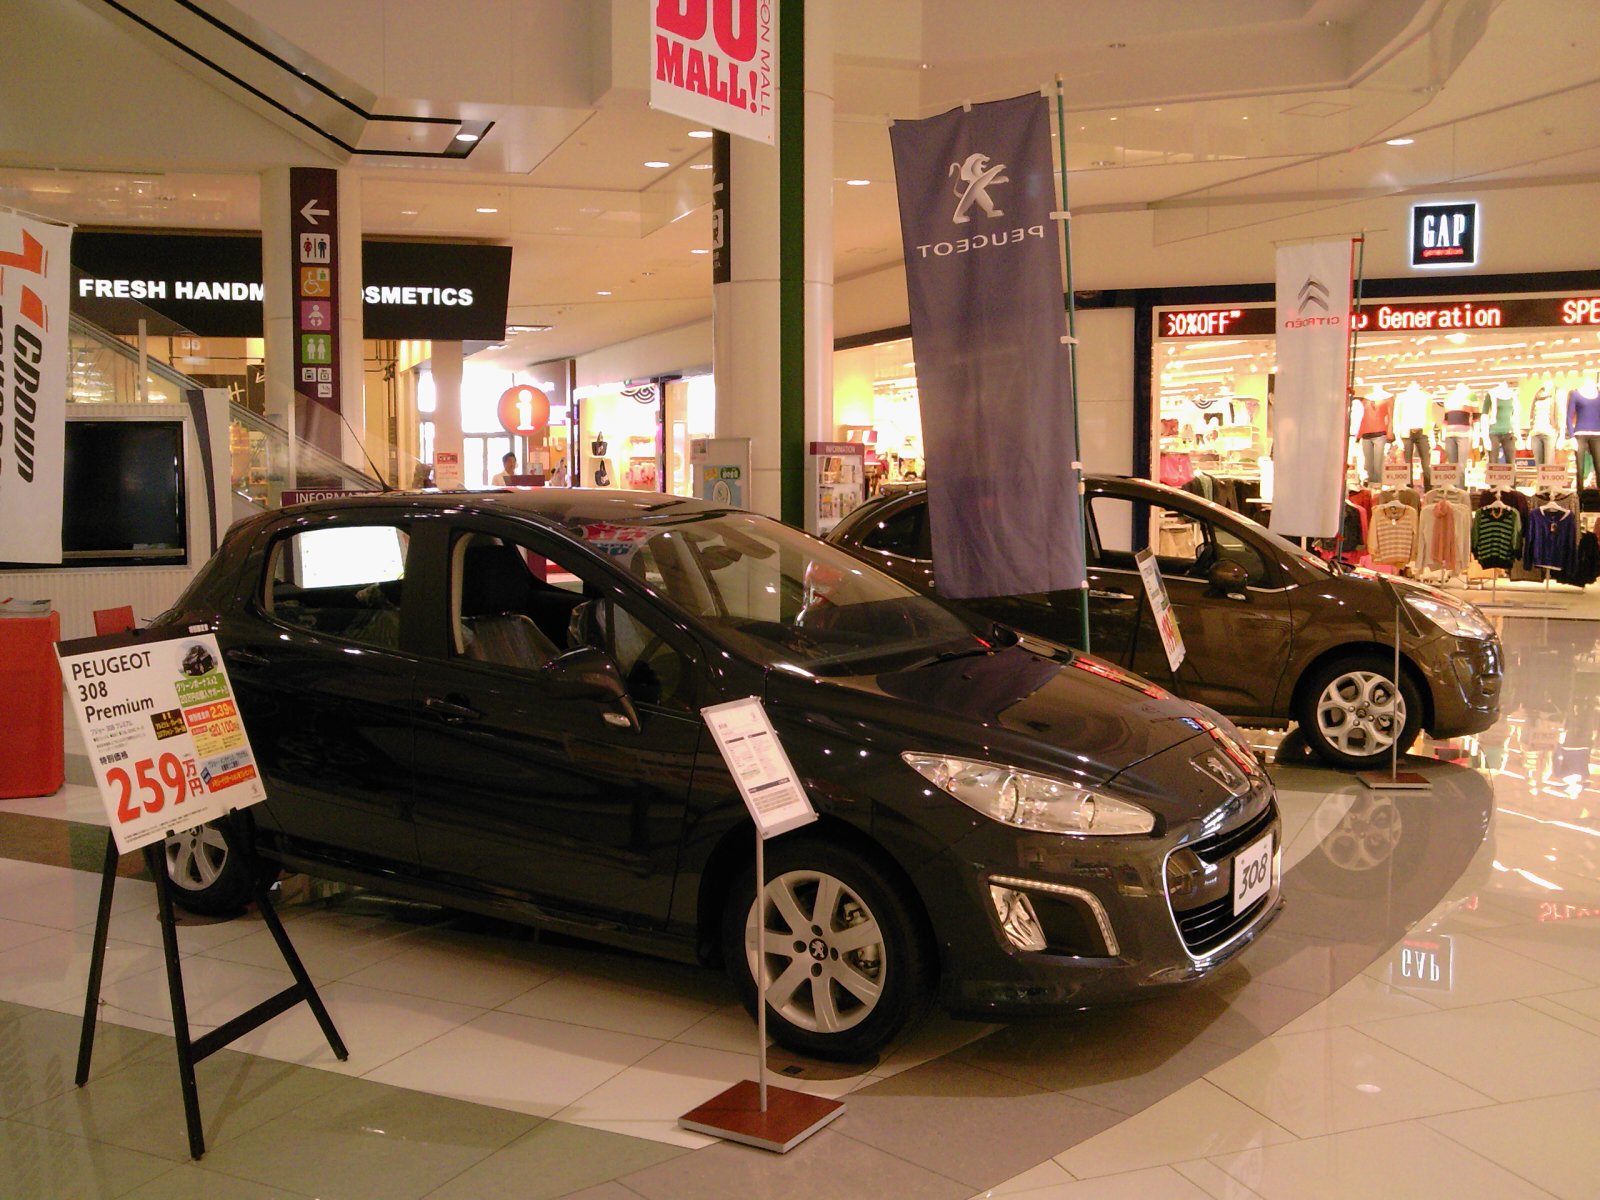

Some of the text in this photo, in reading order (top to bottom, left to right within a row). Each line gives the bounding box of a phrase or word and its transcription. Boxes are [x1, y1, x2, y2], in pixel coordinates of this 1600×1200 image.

[656, 34, 758, 114] MALL!
[760, 49, 771, 116] MALL
[1422, 213, 1466, 248] GAP
[79, 279, 264, 301] FRESH HANDM
[361, 286, 473, 306] SMETICS
[1378, 303, 1501, 329] Generation
[1563, 299, 1600, 324] SPE
[72, 651, 151, 681] PEUGEOT
[78, 681, 108, 702] 308
[85, 697, 154, 723] Premium
[106, 752, 187, 824] 259
[1239, 852, 1268, 900] 308
